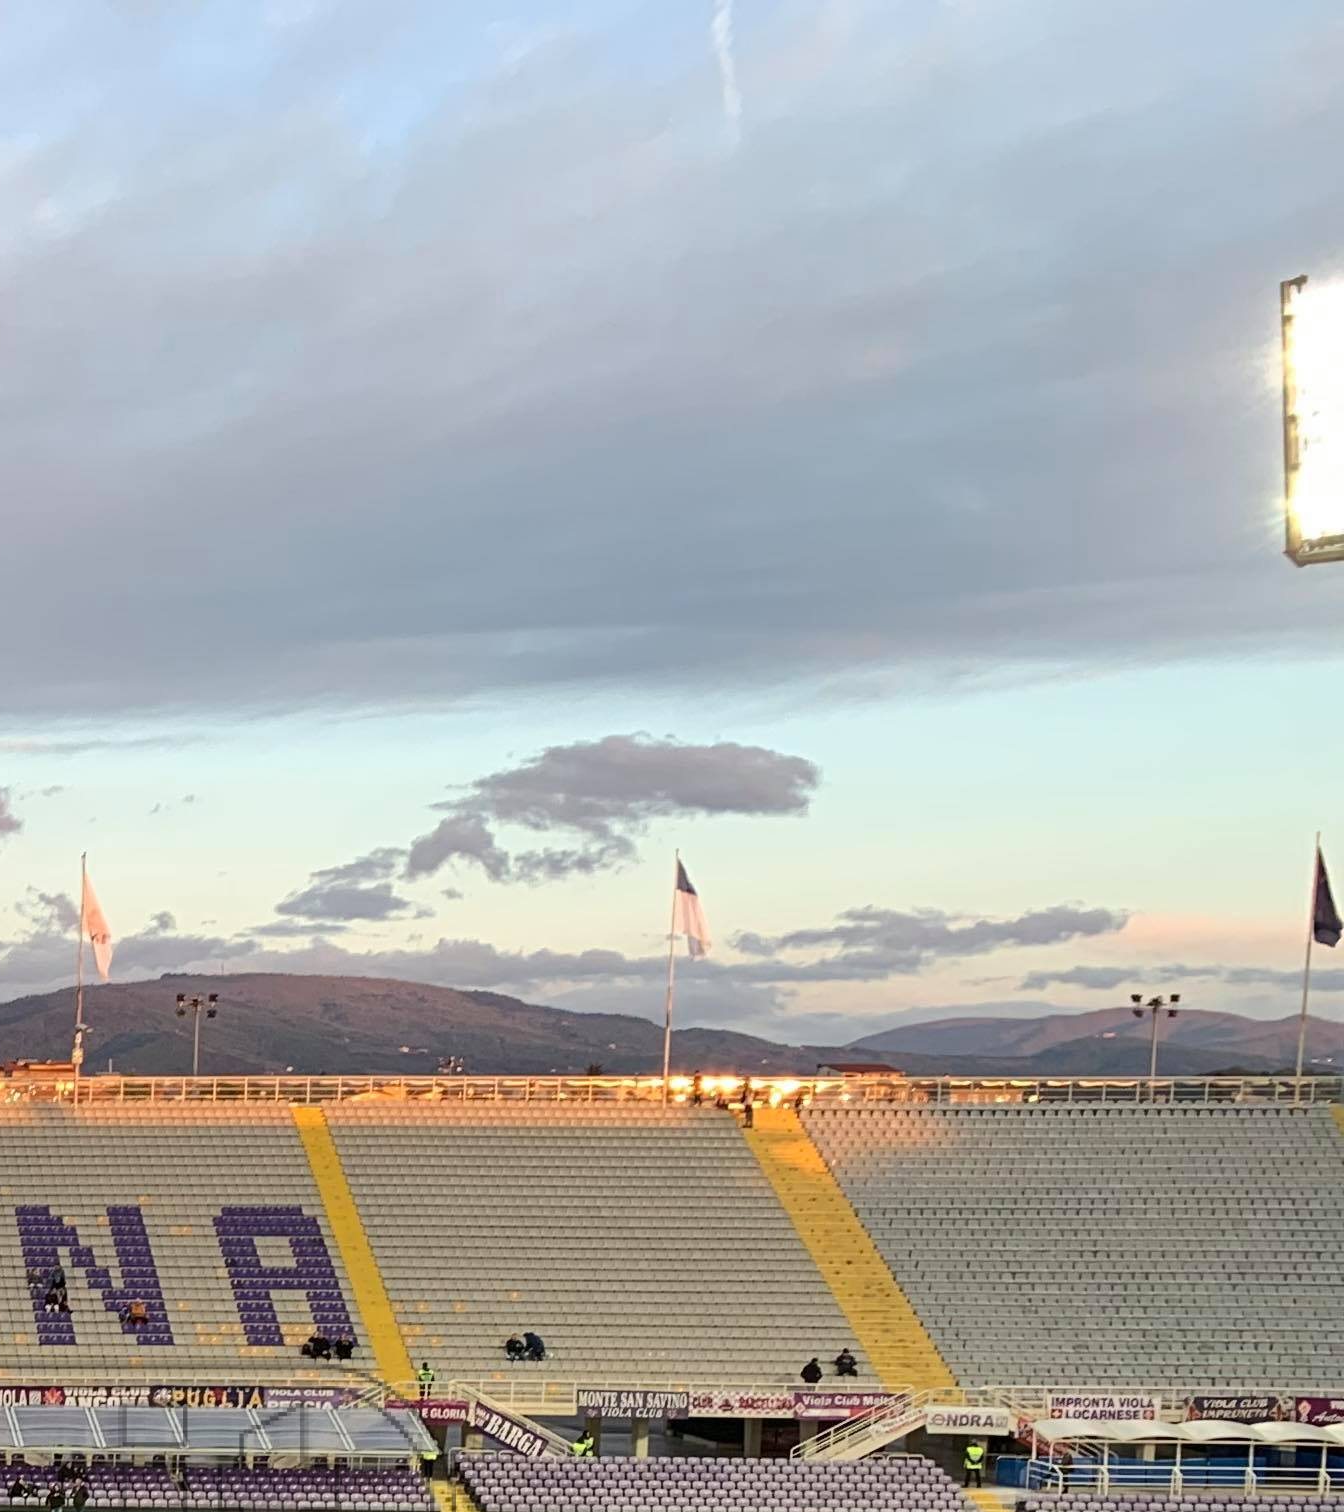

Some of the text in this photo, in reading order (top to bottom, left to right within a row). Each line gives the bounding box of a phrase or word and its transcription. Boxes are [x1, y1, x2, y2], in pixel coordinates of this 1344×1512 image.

[111, 1387, 150, 1396] CLUB
[172, 1390, 263, 1408] PUGLIA
[578, 1391, 688, 1408] MONTE SAN SAVINO
[803, 1395, 832, 1405] Viola
[834, 1395, 860, 1405] Club
[1052, 1397, 1154, 1408] IMPRONTA VIOLA
[430, 1408, 466, 1420] GLORIA
[601, 1408, 662, 1418] VIOLA CLUB
[1065, 1409, 1141, 1420] LOCARNESE
[484, 1413, 543, 1457] BARGA
